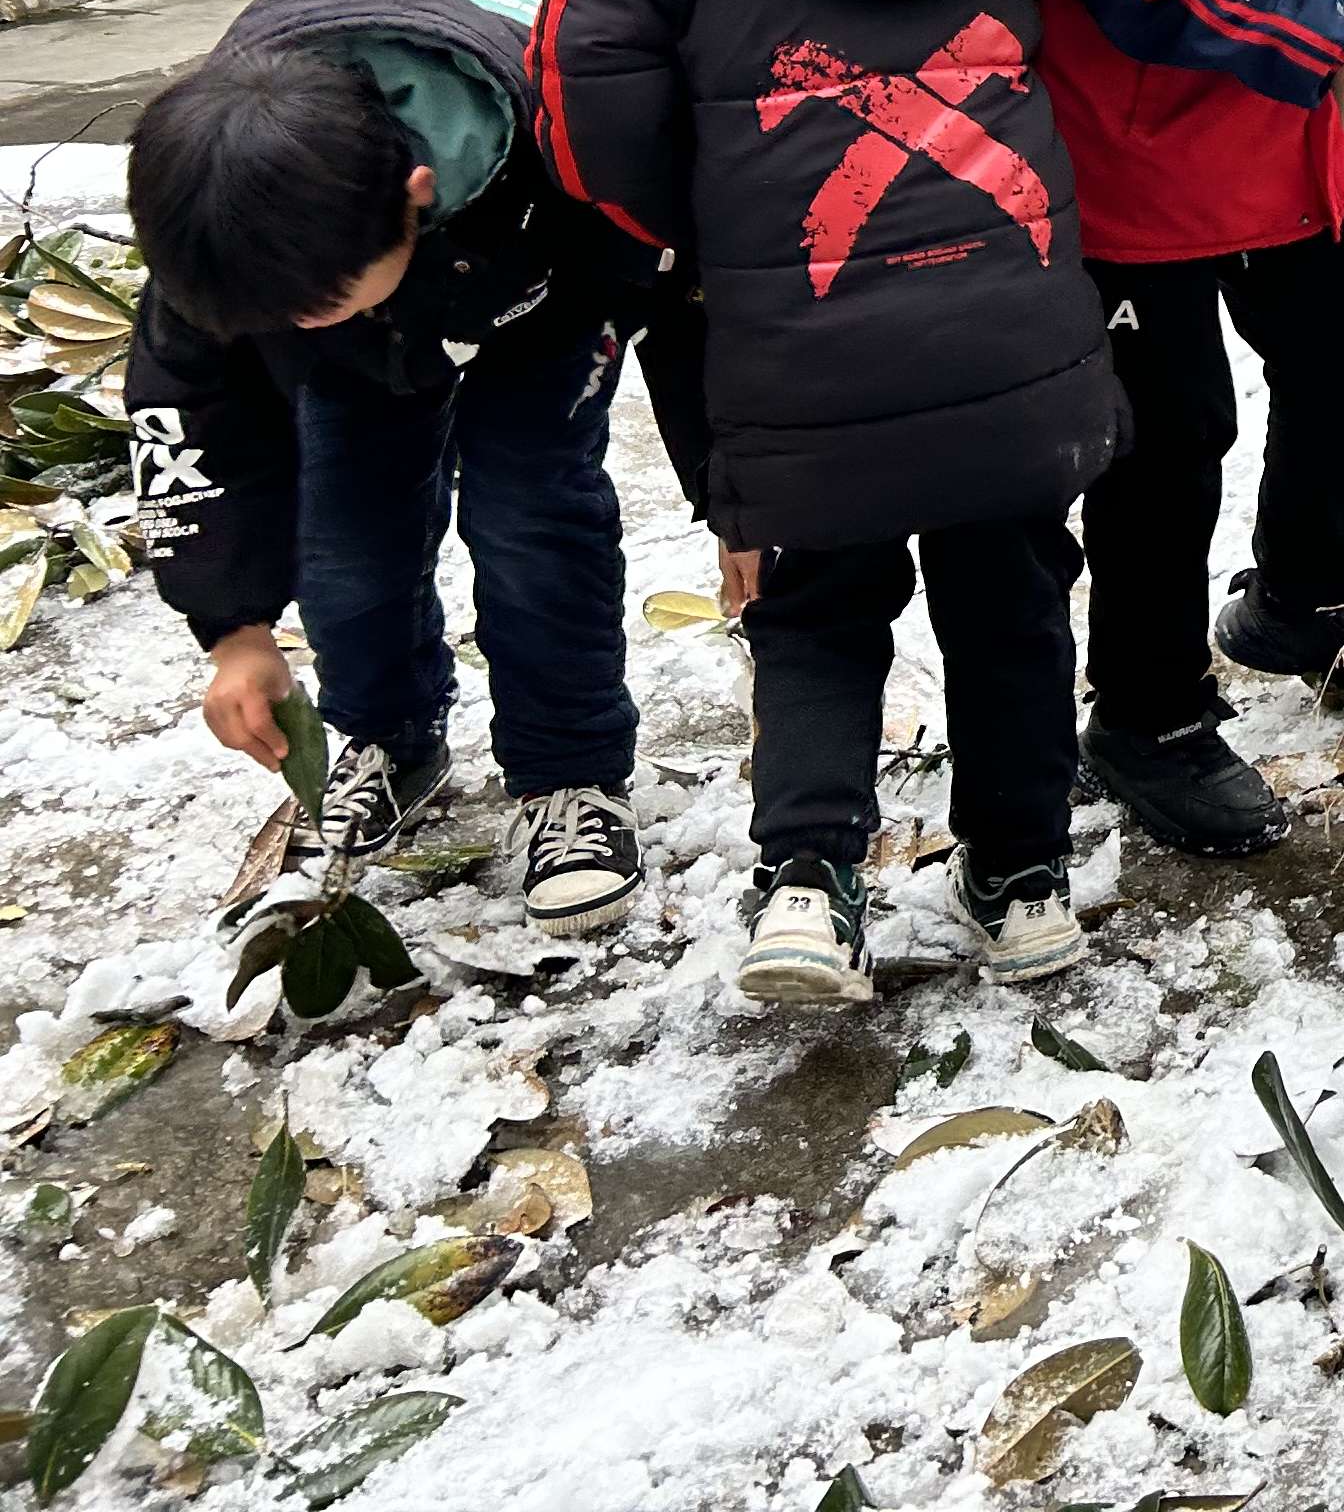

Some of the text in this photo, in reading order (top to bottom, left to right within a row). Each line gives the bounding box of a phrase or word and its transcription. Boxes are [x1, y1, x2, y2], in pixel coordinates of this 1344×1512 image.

[1107, 299, 1140, 330] A
[786, 896, 811, 912] 23
[1023, 901, 1047, 919] 23
